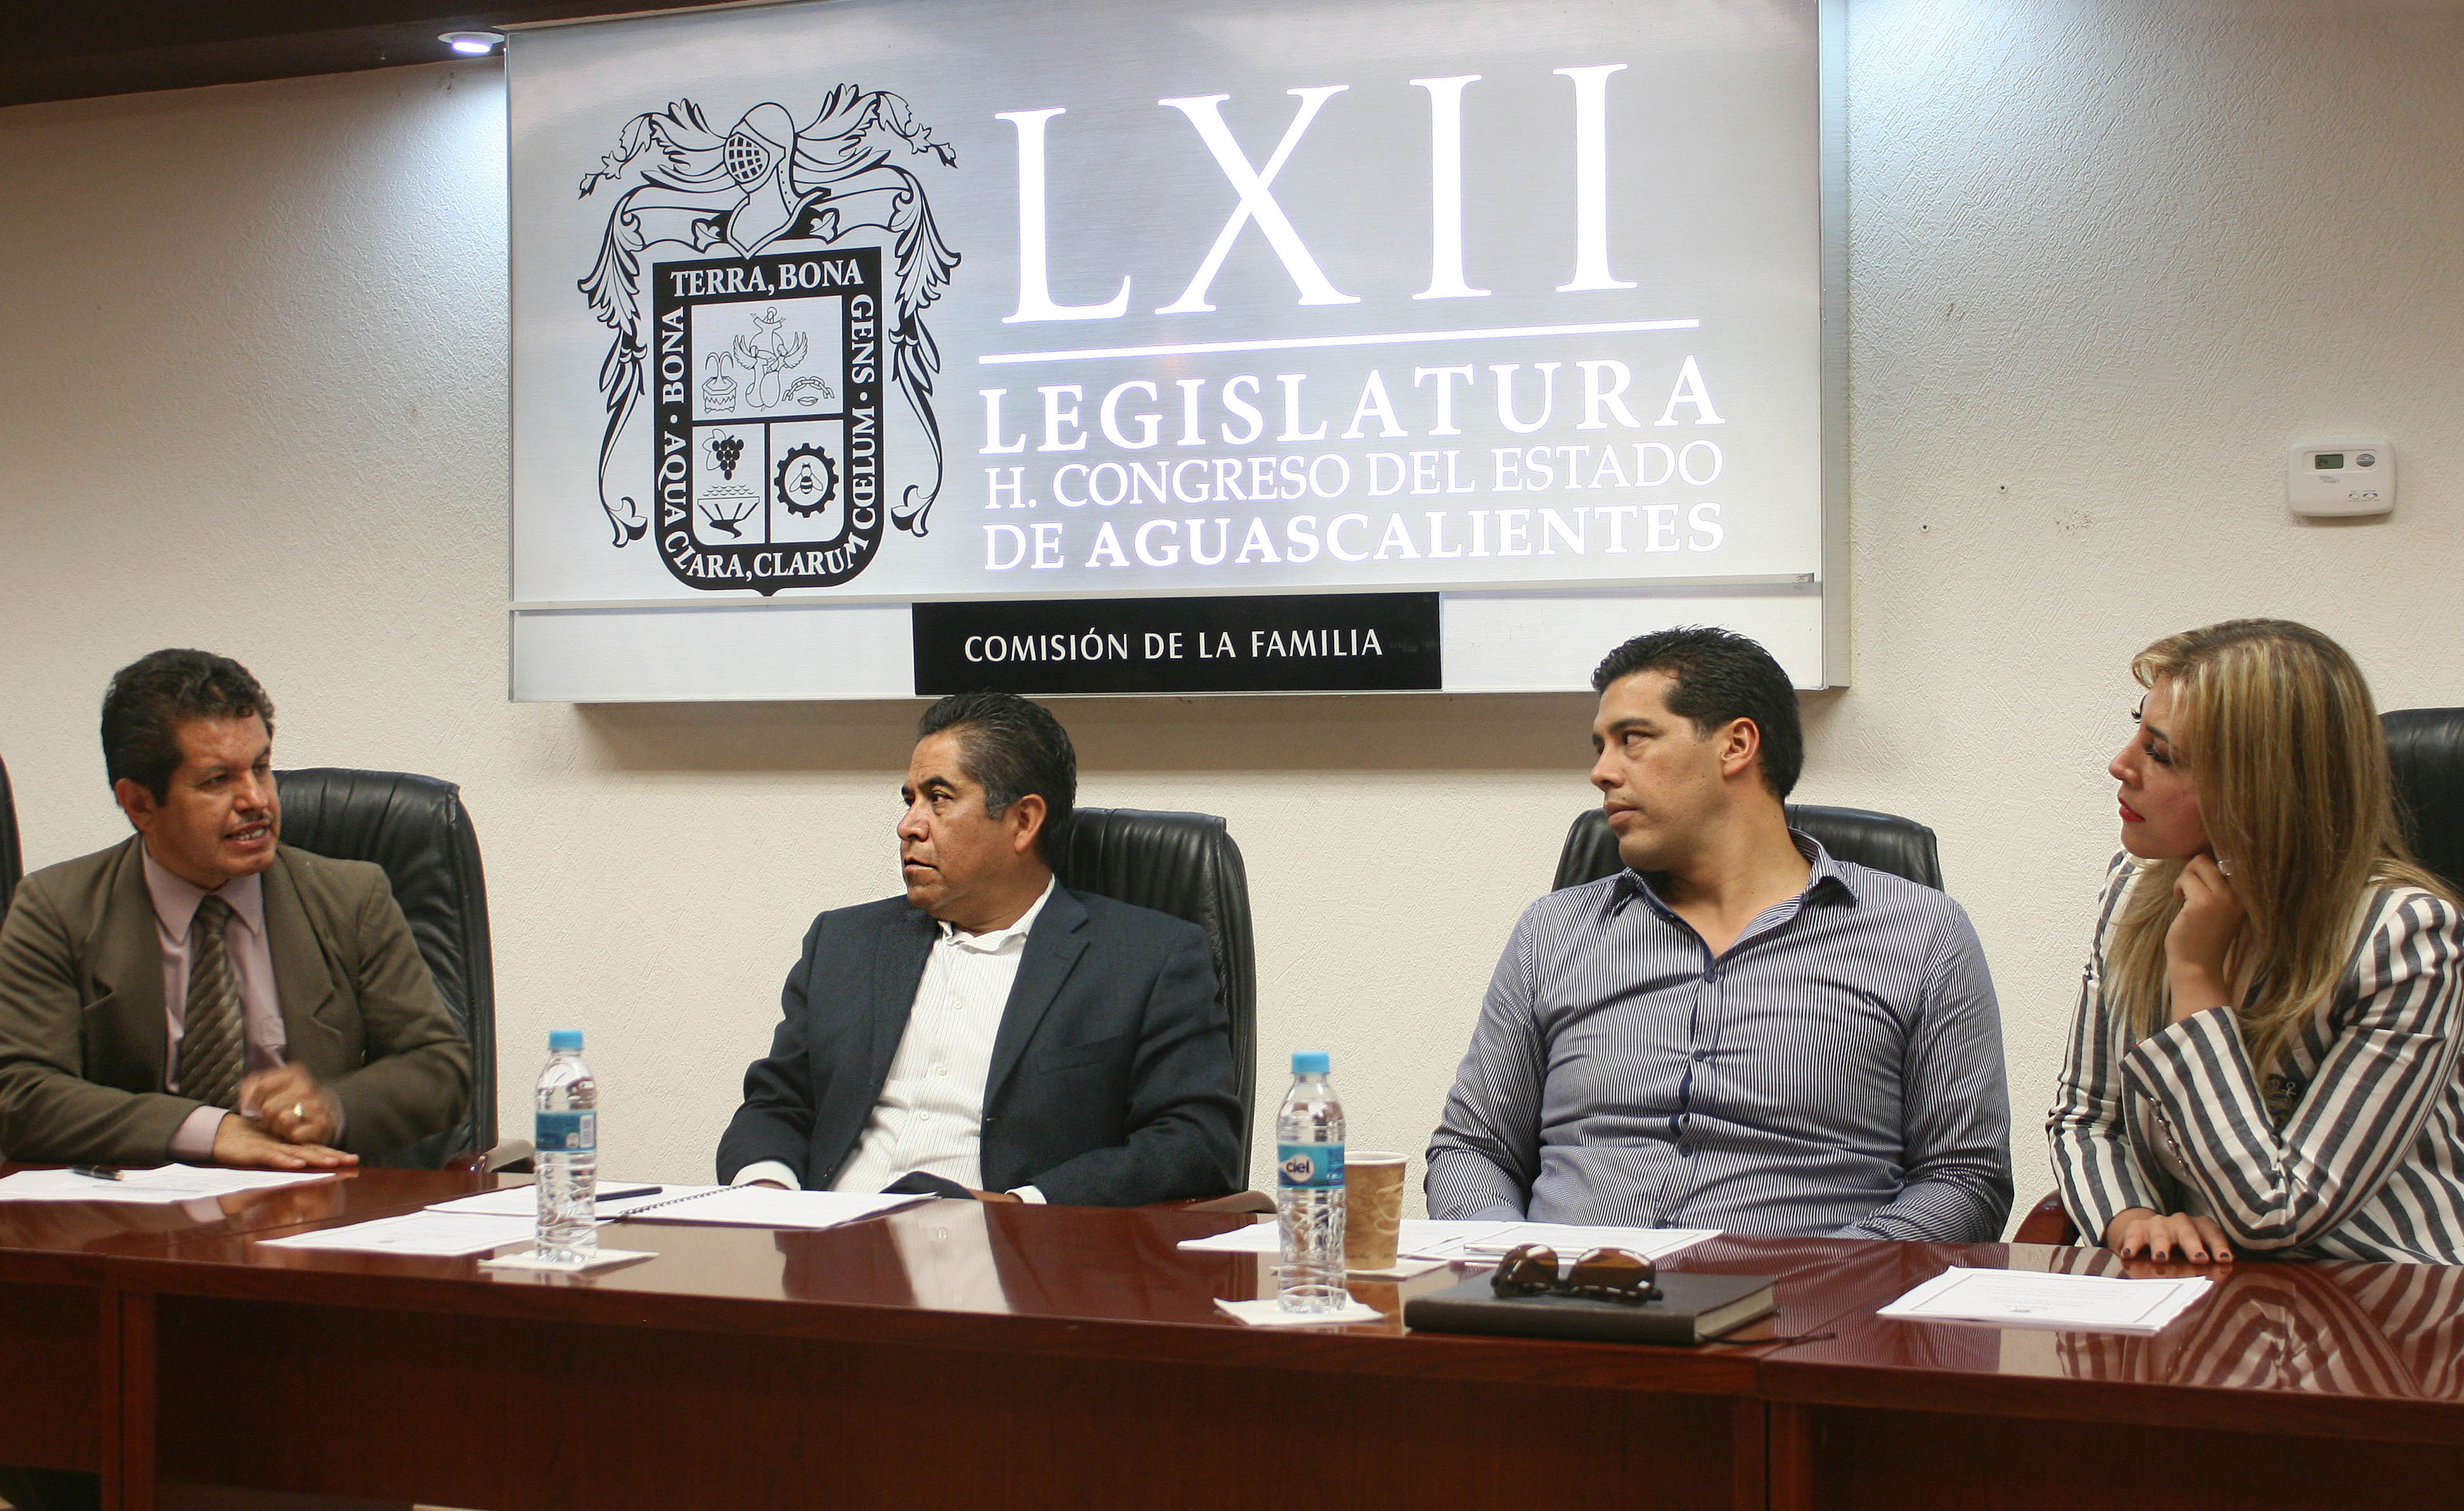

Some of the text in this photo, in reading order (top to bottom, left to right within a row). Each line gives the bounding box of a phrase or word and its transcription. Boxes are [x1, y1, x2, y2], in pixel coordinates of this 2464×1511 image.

[994, 61, 1638, 325] LXII
[670, 259, 864, 297] TERRA, BONA
[662, 306, 685, 404] BONA
[850, 293, 875, 385] GENS
[978, 354, 1726, 455] LEGISLATURA
[658, 430, 687, 527] AQUA
[984, 439, 1724, 510] H. CONGRESO DEL ESTADO
[665, 530, 869, 582] CLARA, CLARUM
[983, 501, 1726, 571] DE AGUASCALIENTES
[965, 627, 1383, 662] COMISIÓN DE LA FAMILIA
[1286, 1159, 1310, 1173] ciel
